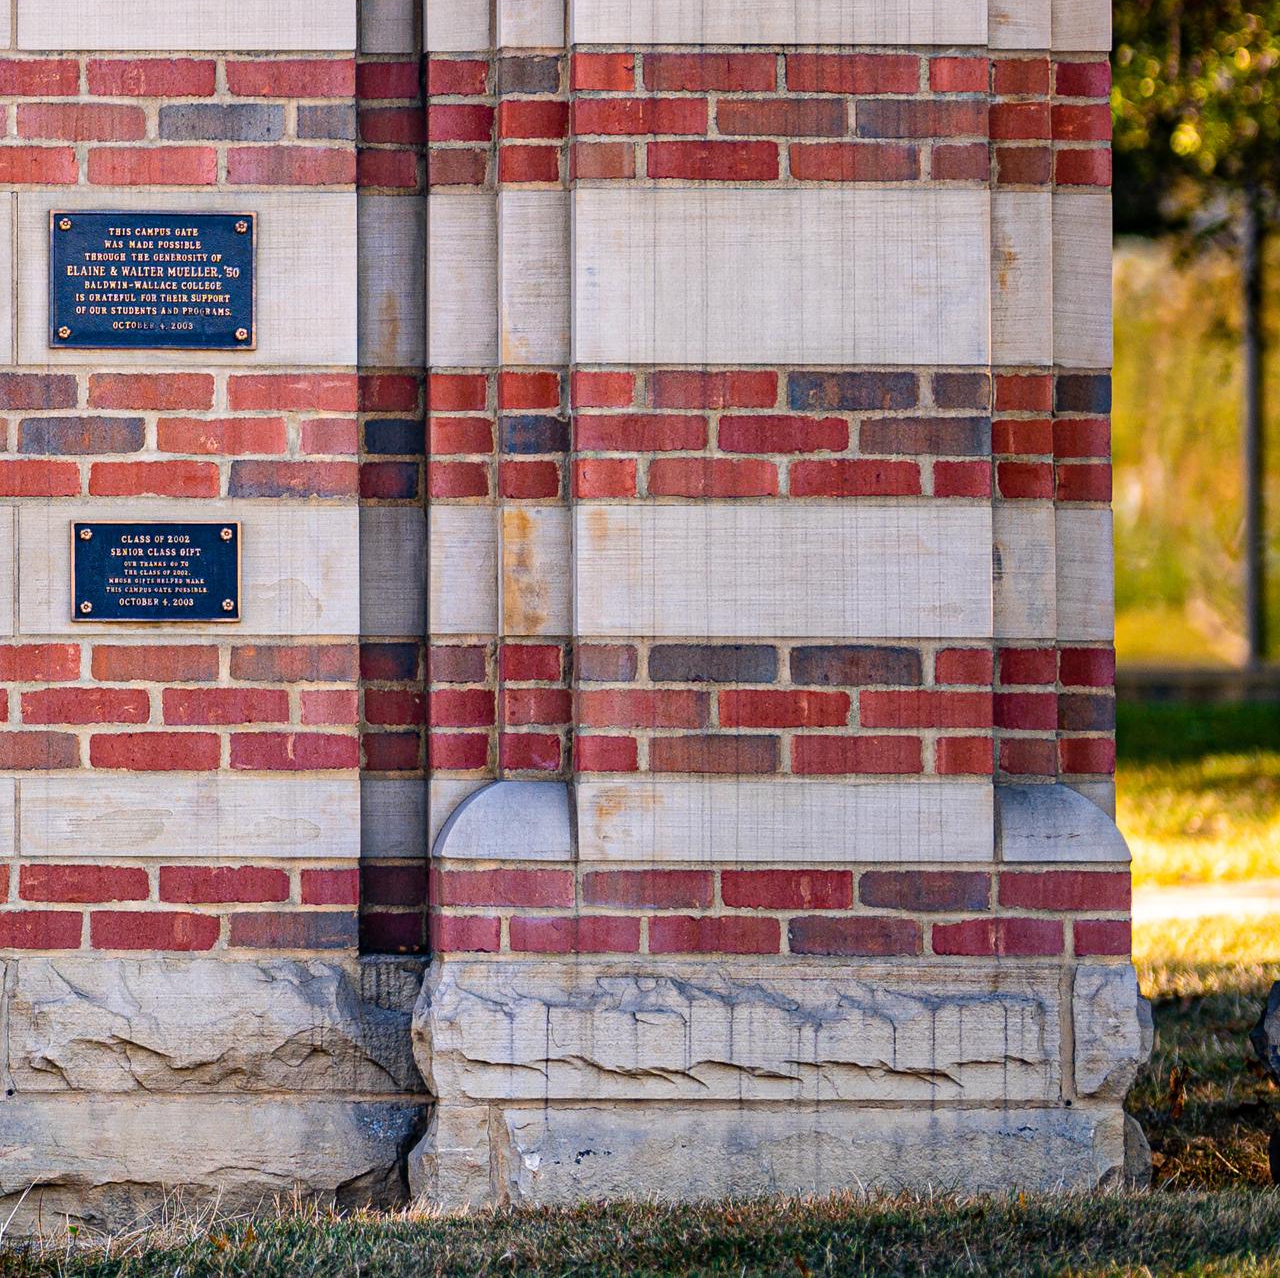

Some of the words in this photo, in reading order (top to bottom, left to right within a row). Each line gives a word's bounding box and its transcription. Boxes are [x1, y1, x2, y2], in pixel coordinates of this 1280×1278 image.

[109, 228, 131, 236] THIS
[135, 228, 170, 236] CAMPUS
[175, 228, 198, 236] GATE
[104, 240, 123, 248] WAS
[158, 241, 201, 249] POSSIBLE
[85, 253, 126, 261] THROUGH
[211, 254, 222, 262] OF
[67, 266, 105, 276] ELAINE
[110, 267, 118, 276] &
[121, 266, 163, 276] WALTER
[168, 267, 222, 278] MUELLER,
[85, 281, 177, 289] BALDWIN-WALLACE
[182, 282, 222, 290] COLLEGE
[171, 322, 193, 330] 2003
[121, 535, 150, 543] CLASS
